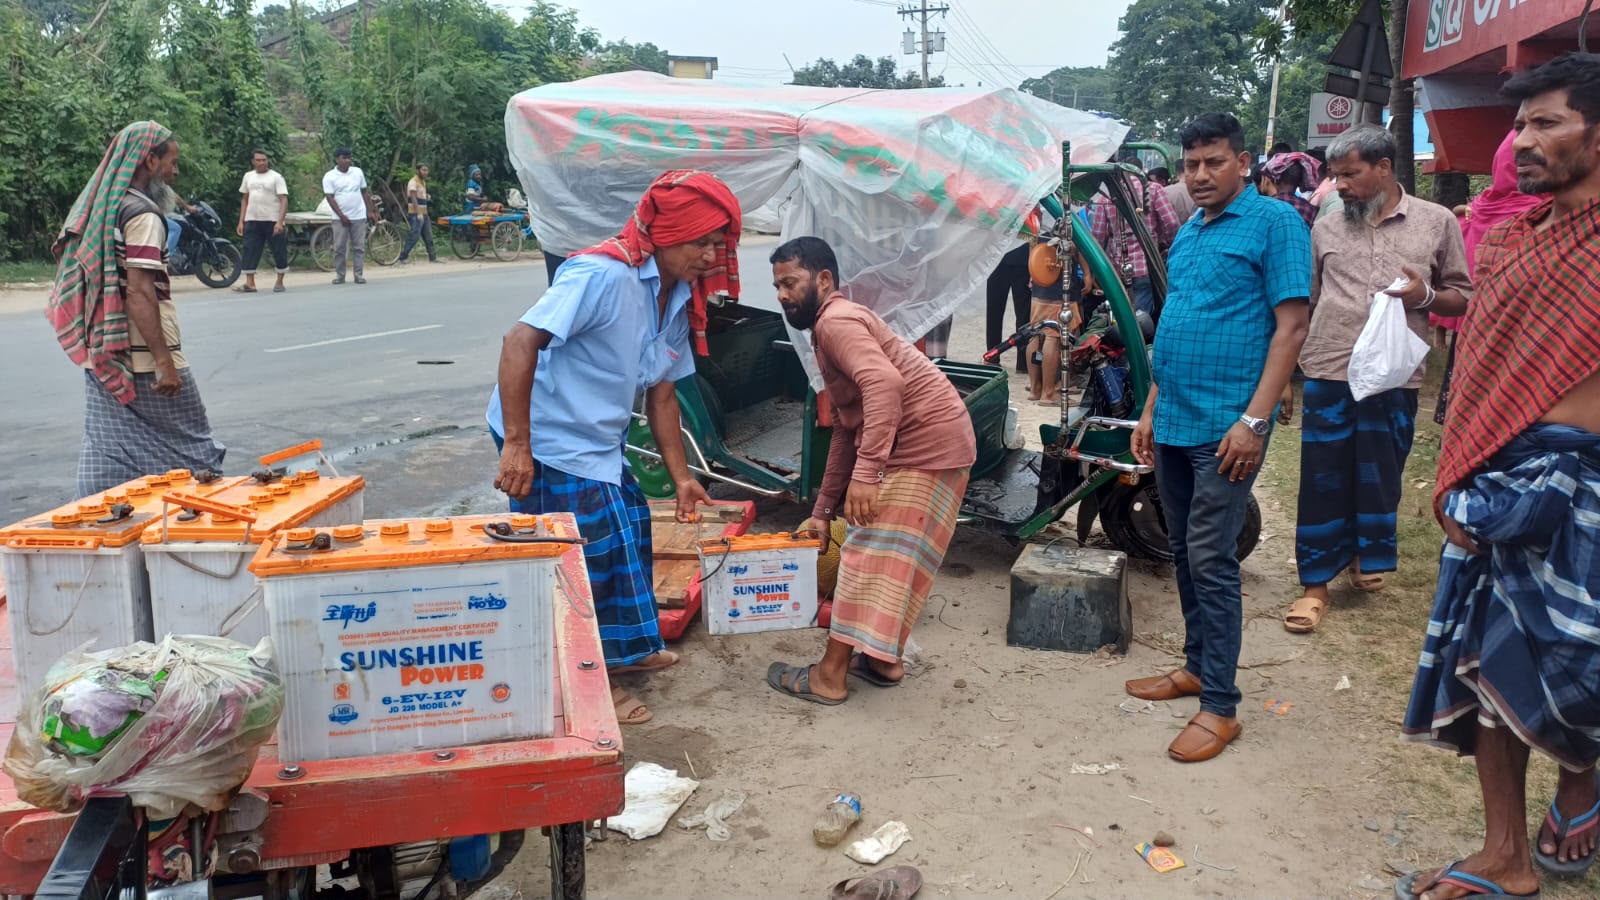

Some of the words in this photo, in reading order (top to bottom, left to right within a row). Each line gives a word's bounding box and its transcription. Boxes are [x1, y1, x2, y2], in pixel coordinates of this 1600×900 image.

[733, 584, 789, 595] SUNSHINE
[757, 593, 790, 602] POWER
[341, 641, 483, 671] SUNSHINE
[401, 664, 484, 686] POWER
[419, 702, 448, 711] MODEL
